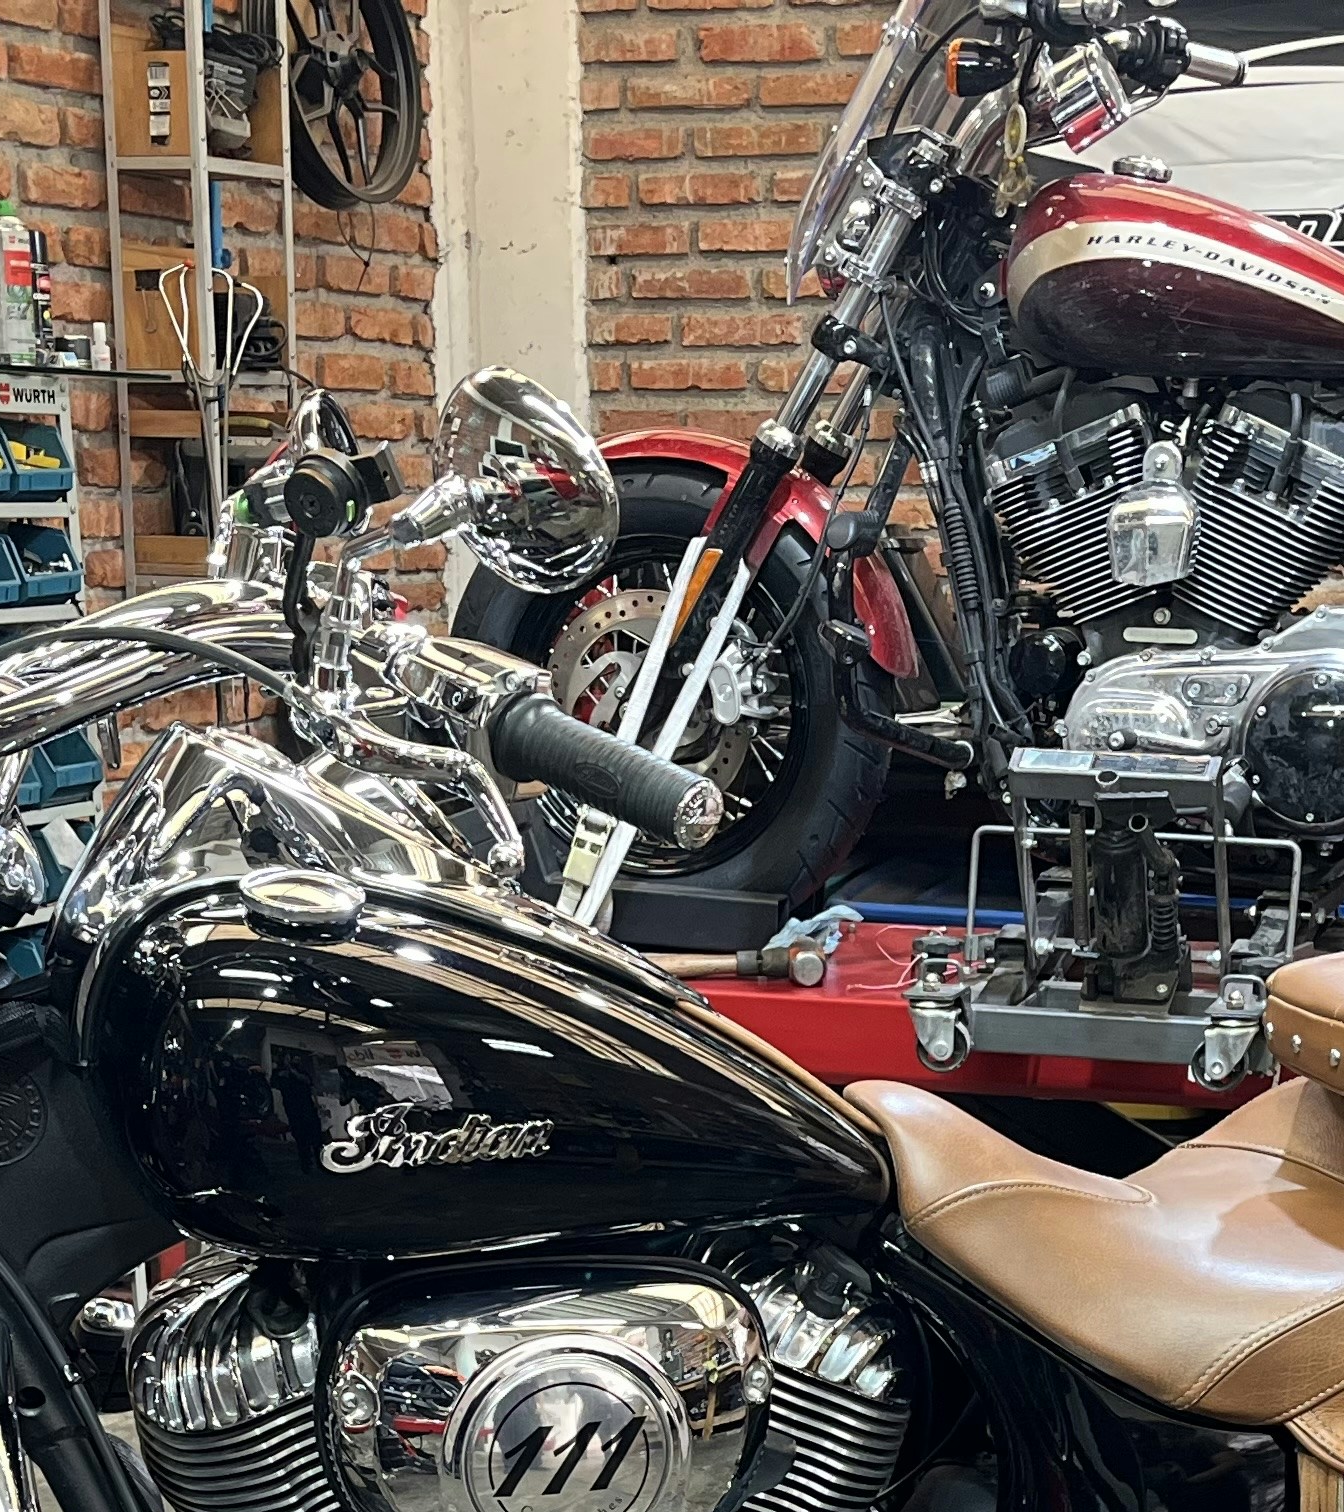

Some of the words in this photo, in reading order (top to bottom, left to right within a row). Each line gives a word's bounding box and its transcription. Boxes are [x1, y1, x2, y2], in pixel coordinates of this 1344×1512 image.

[1086, 234, 1332, 305] HARLEY-DAVIDSON
[320, 1101, 555, 1174] Indian
[493, 1415, 647, 1498] 111
